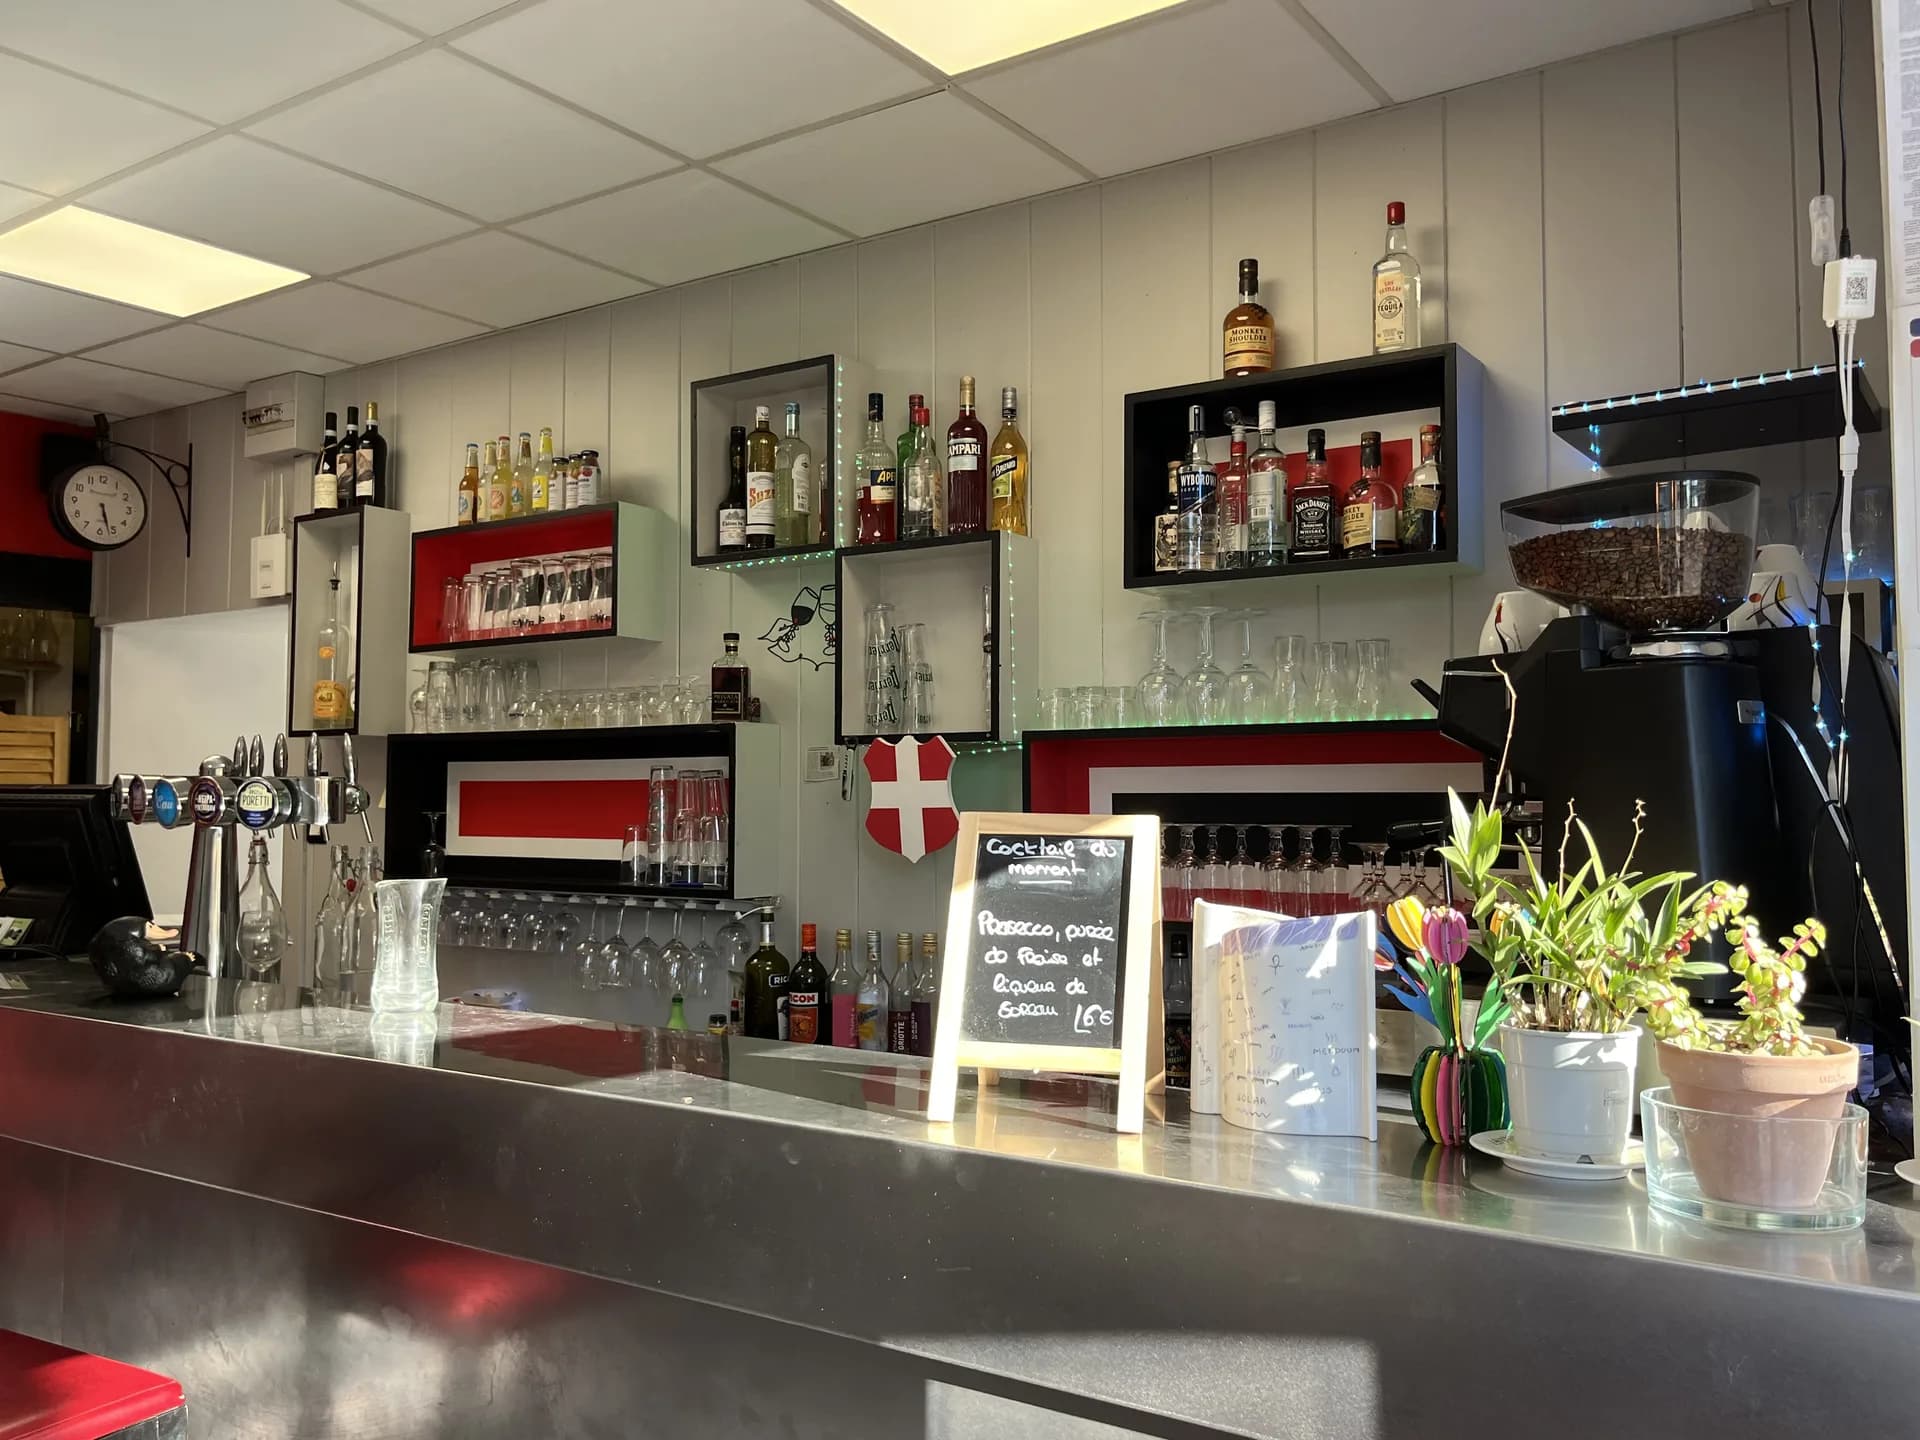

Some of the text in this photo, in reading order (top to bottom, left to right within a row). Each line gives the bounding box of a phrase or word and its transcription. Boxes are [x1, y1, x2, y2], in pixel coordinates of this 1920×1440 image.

[1231, 328, 1264, 337] MONKEY
[948, 443, 981, 456] AMPARI
[87, 475, 94, 485] 11
[99, 475, 108, 485] 12
[877, 470, 897, 484] APE
[1181, 473, 1217, 487] WYBOROW
[75, 483, 84, 493] 10
[71, 496, 78, 504] 9
[121, 493, 129, 502] 2
[74, 510, 80, 518] 8
[126, 506, 133, 515] 3
[83, 520, 90, 529] 7
[120, 519, 127, 527] 4
[96, 527, 103, 536] 6
[110, 525, 117, 535] 5
[242, 795, 270, 807] PORETTI
[986, 837, 1118, 858] Cocktail du
[1007, 860, 1086, 877] moment
[1082, 946, 1104, 967] et
[773, 974, 788, 986] RIC
[993, 972, 1089, 997] liqueur de
[789, 993, 816, 1004] ICON
